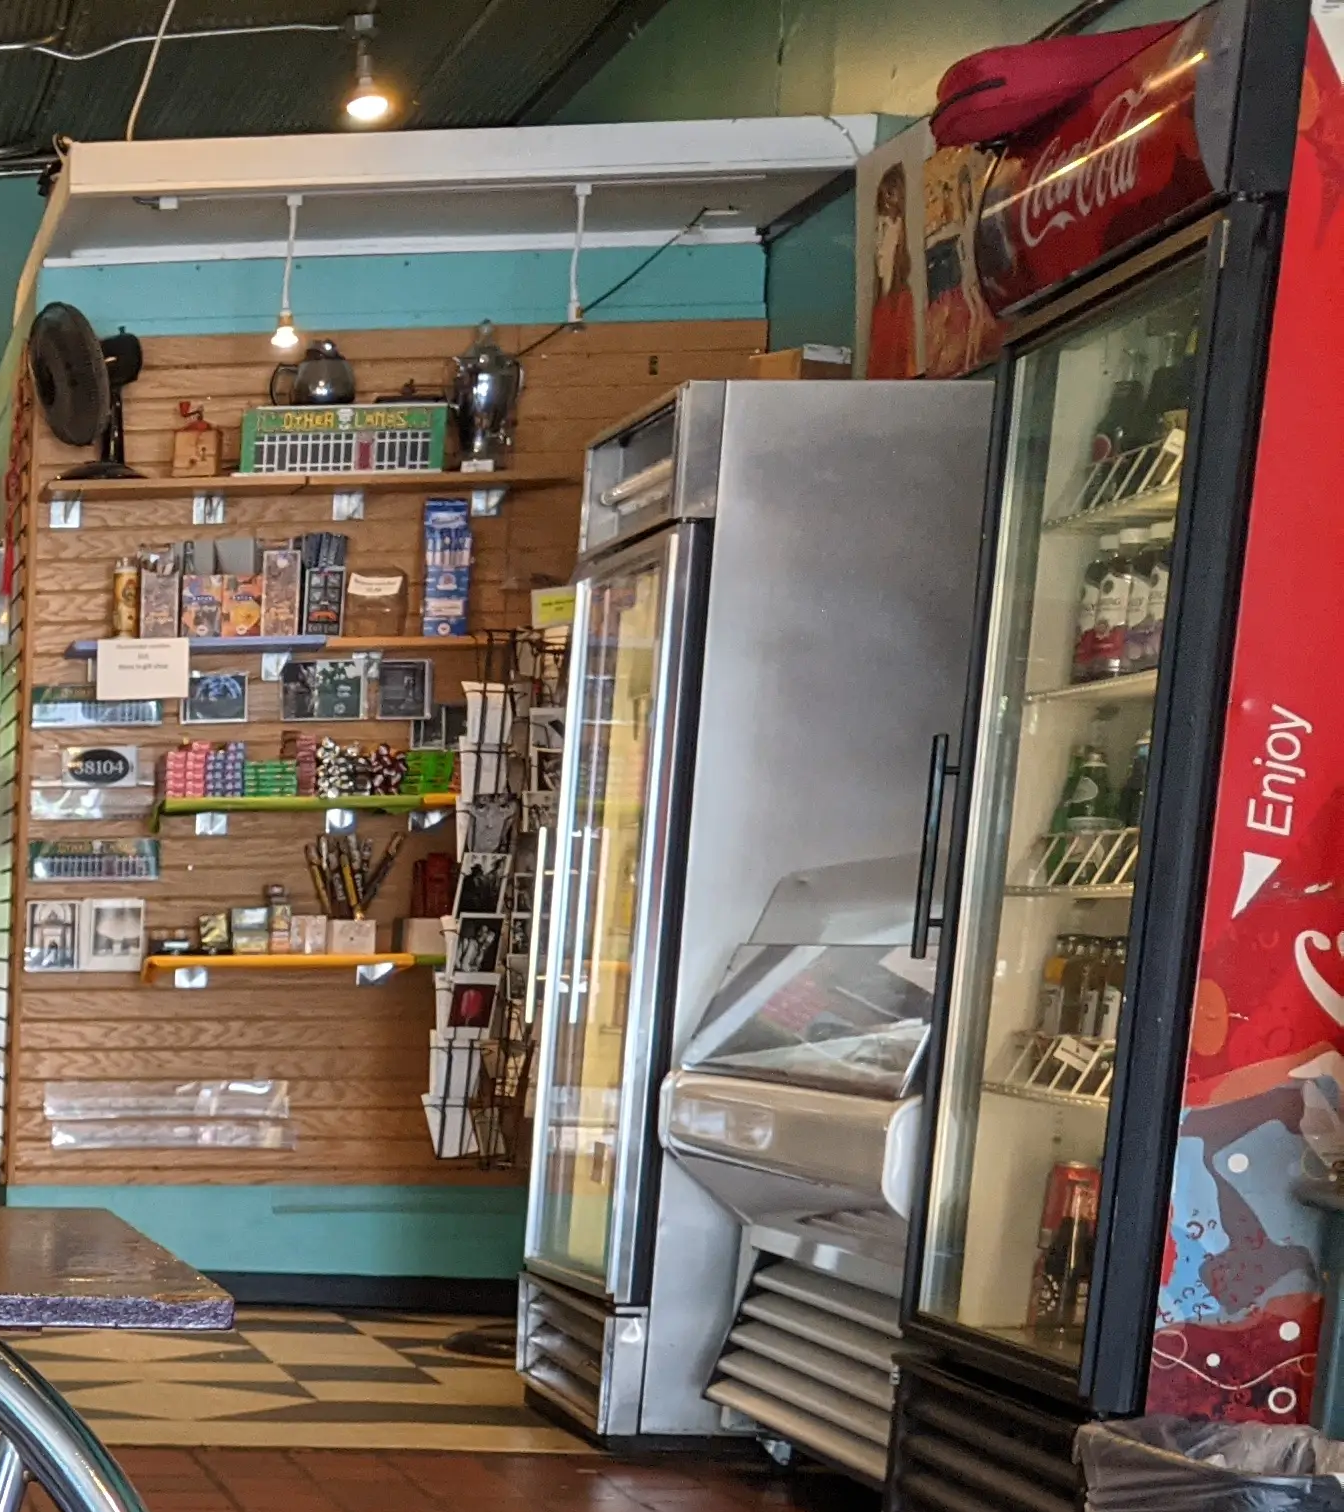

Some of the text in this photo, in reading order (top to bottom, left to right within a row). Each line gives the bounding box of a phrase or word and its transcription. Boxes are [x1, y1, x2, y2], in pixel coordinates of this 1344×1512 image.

[1020, 80, 1150, 249] Coca-Cola
[74, 759, 125, 775] 38104
[1246, 704, 1313, 837] Enjoy
